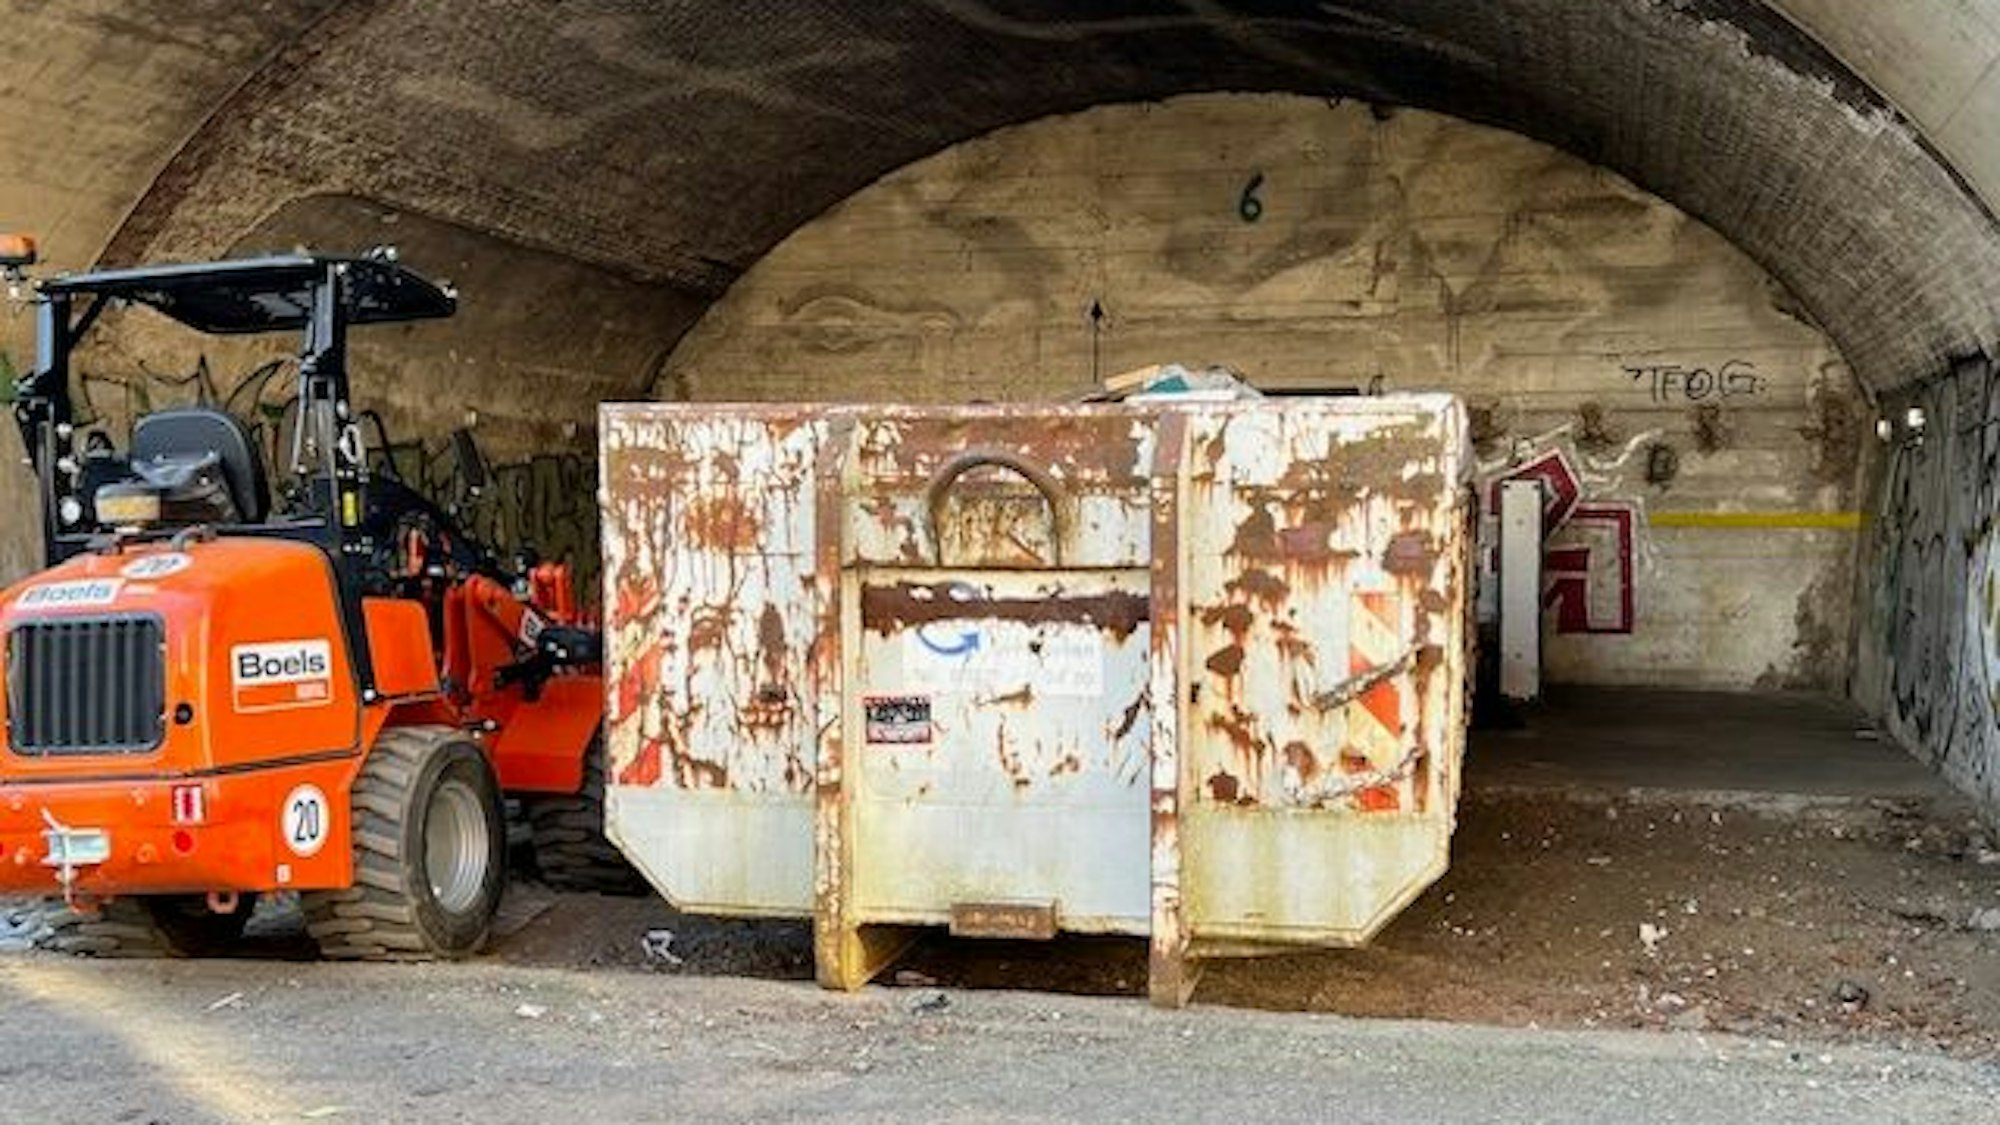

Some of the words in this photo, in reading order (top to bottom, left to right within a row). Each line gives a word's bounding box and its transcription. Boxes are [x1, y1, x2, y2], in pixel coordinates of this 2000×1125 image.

[1240, 173, 1264, 223] 6
[238, 650, 325, 678] Boels
[293, 799, 319, 842] 20
